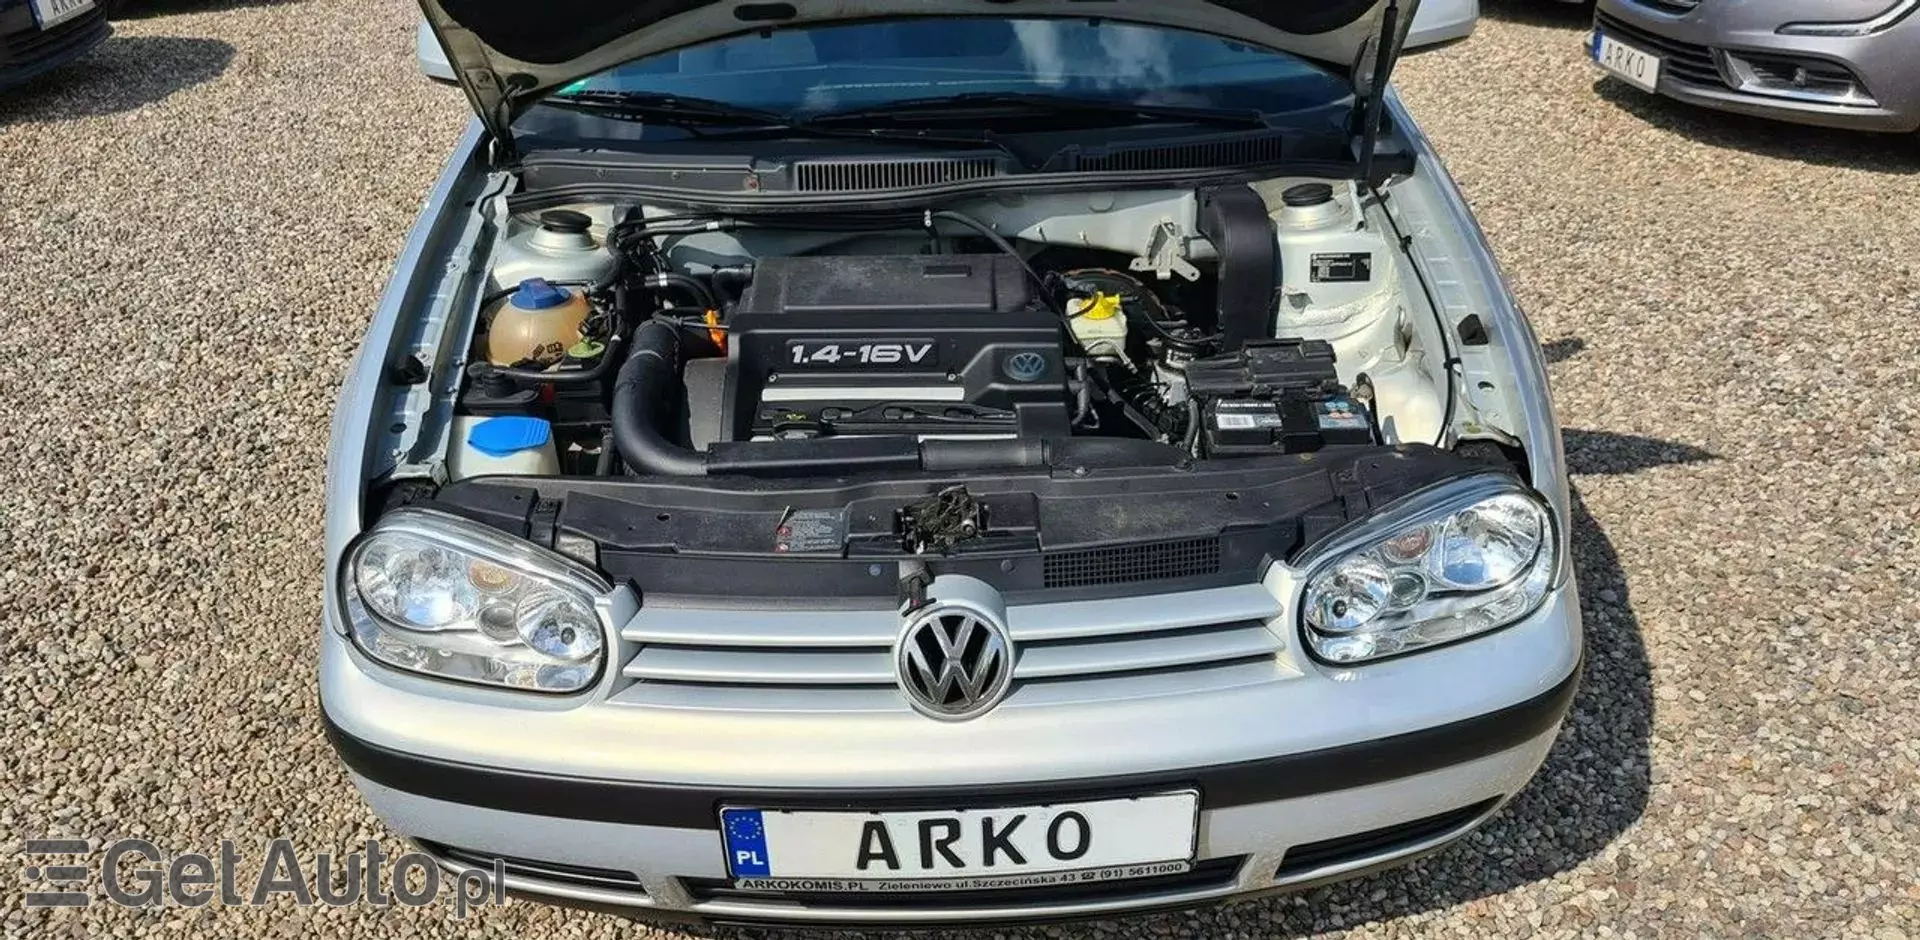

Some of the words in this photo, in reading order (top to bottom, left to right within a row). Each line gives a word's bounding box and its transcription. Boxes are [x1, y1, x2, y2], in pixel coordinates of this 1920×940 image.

[1605, 43, 1645, 77] ARKO
[792, 344, 932, 363] 1.4-16V
[856, 811, 1091, 869] ARKO
[736, 849, 764, 866] PL
[742, 879, 869, 891] ARKOKOMIS.PL
[878, 879, 951, 890] Zieleniewo
[1060, 873, 1076, 882] 43
[1100, 869, 1123, 880] (91)
[1129, 863, 1182, 876] 5611000
